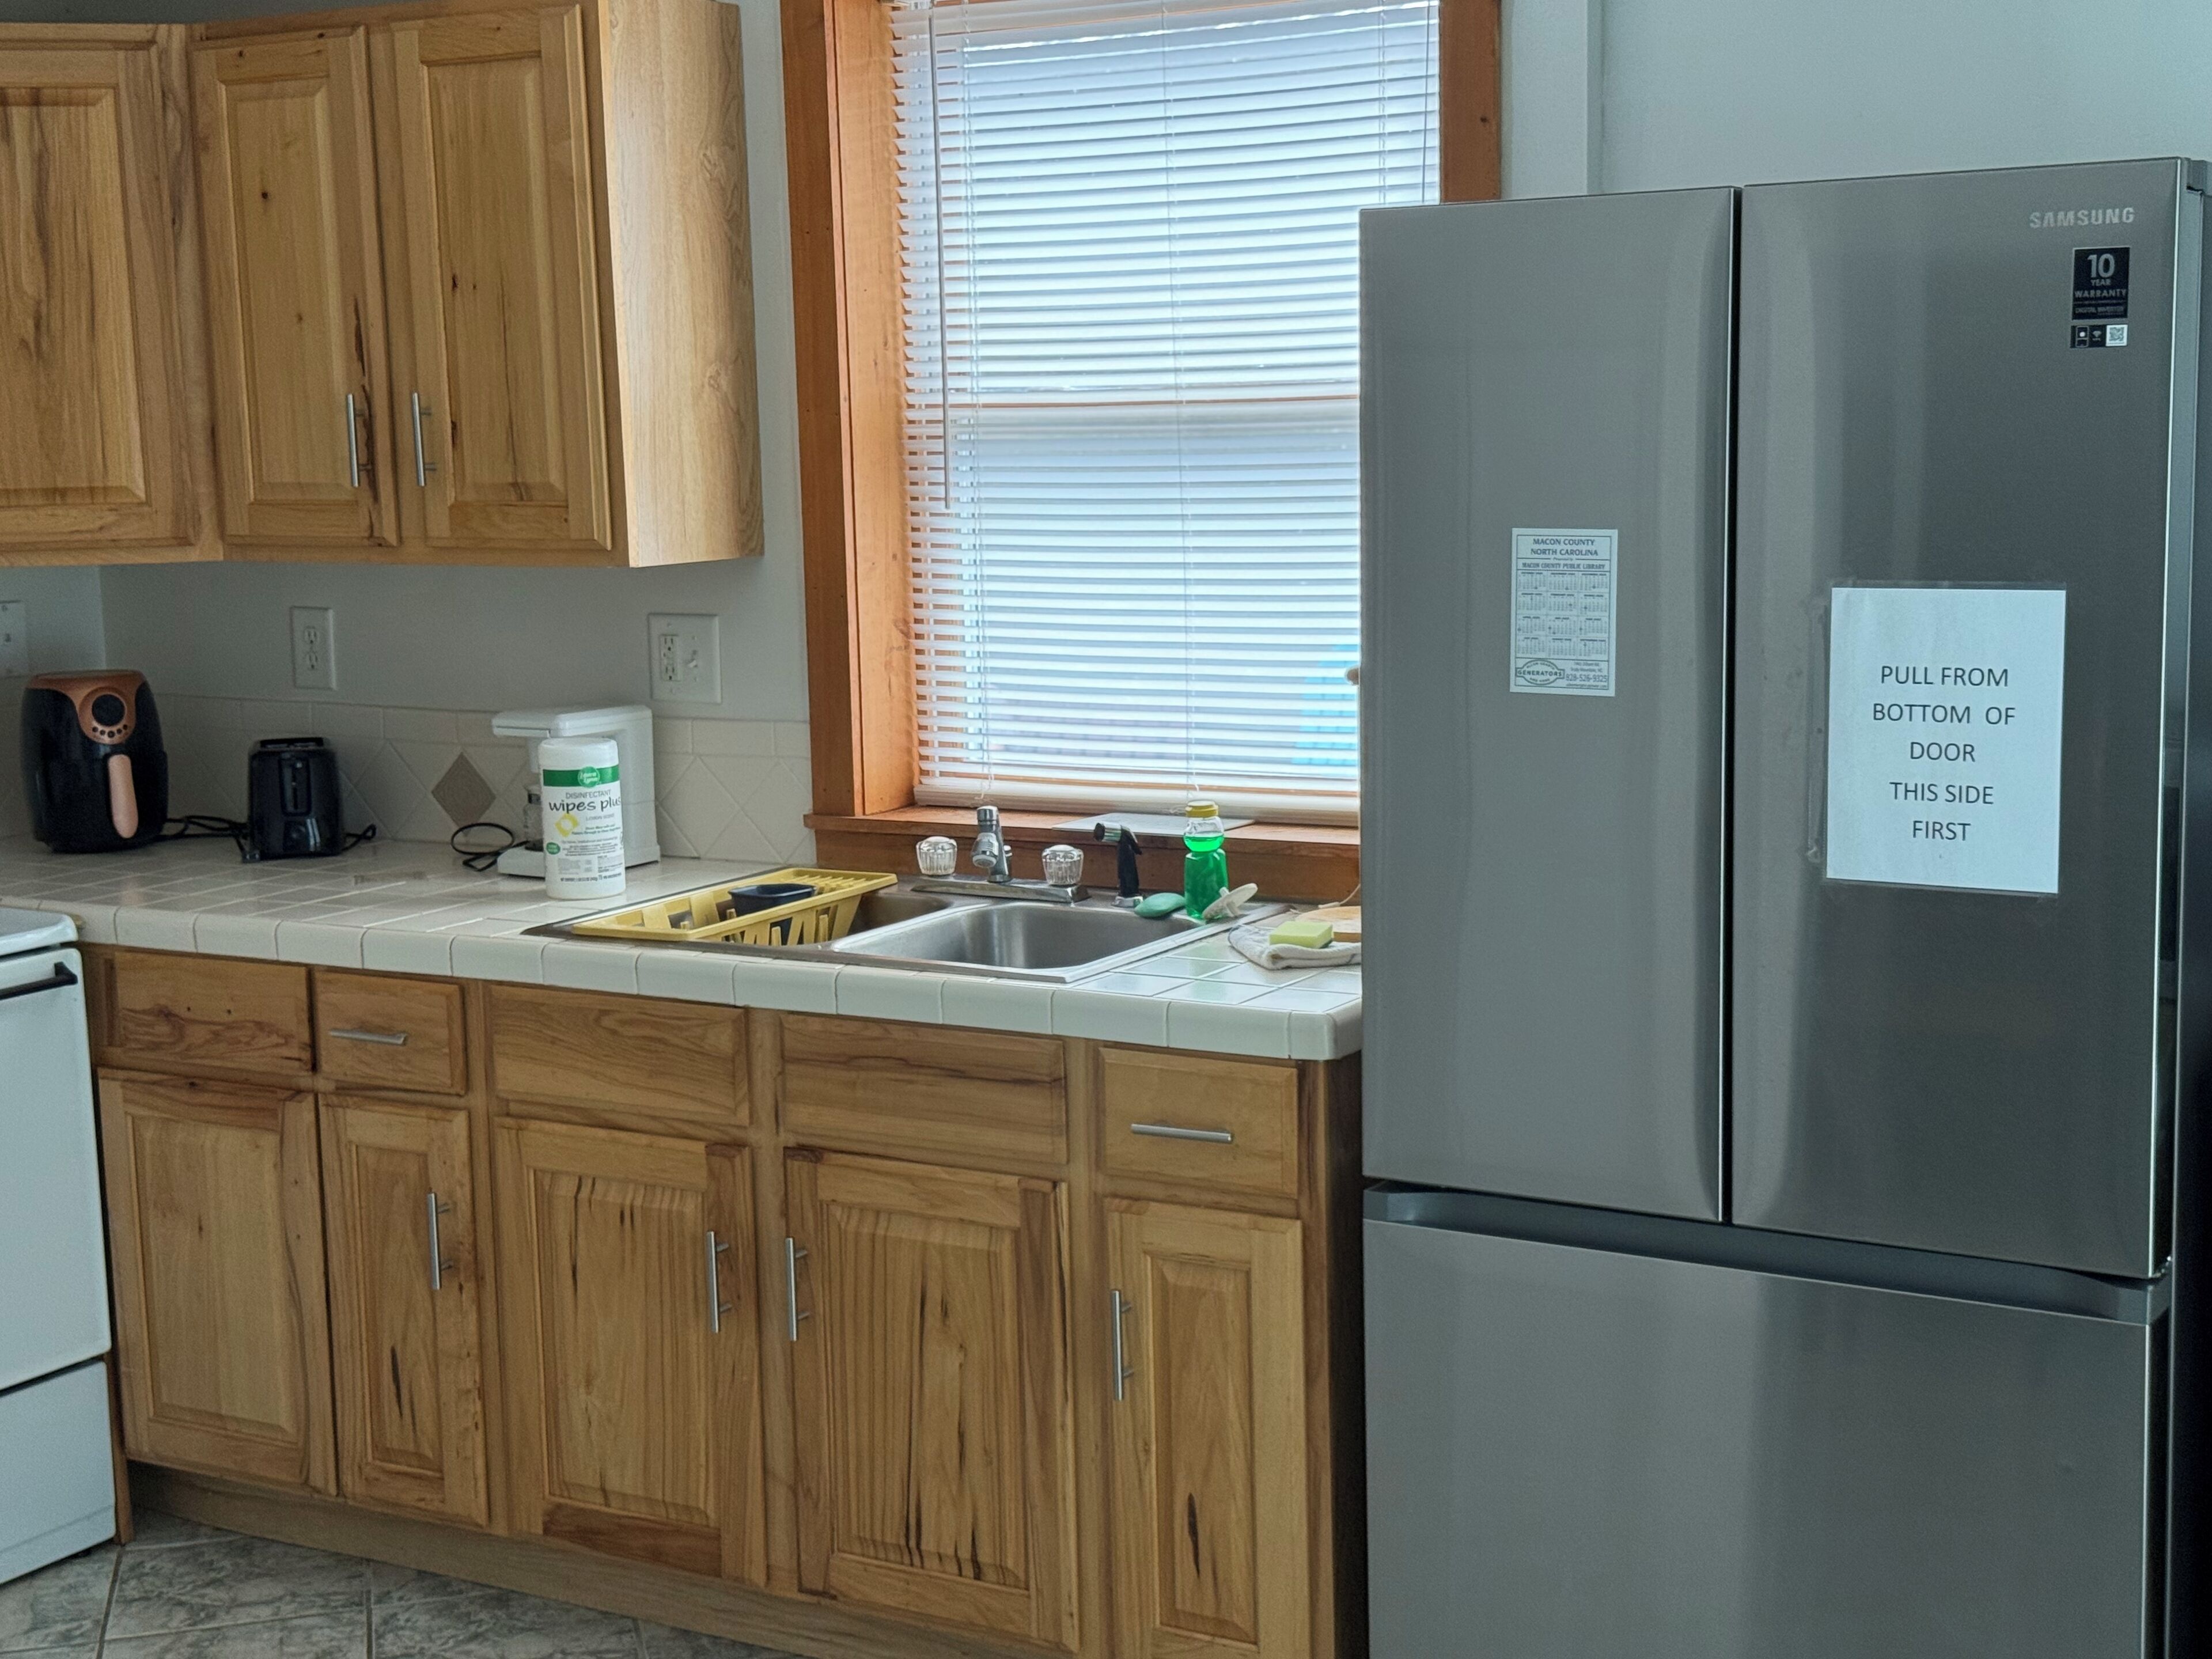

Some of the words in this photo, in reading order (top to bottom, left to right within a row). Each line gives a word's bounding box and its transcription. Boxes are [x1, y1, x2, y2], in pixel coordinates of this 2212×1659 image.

[2029, 207, 2135, 229] SAMSUNG
[2087, 253, 2115, 278] 10
[2074, 289, 2127, 298] WARRANTY
[1881, 665, 1934, 685] PULL
[1941, 667, 2008, 687] FROM
[1873, 703, 1971, 724] BOTTOM
[1985, 706, 2016, 725] OF
[1910, 741, 1976, 762] DOOR
[565, 789, 611, 800] DISINFECTANT
[1889, 782, 1938, 802] THIS
[1945, 785, 1994, 805] SIDE
[548, 800, 597, 815] wipes
[1912, 820, 1971, 841] FIRST
